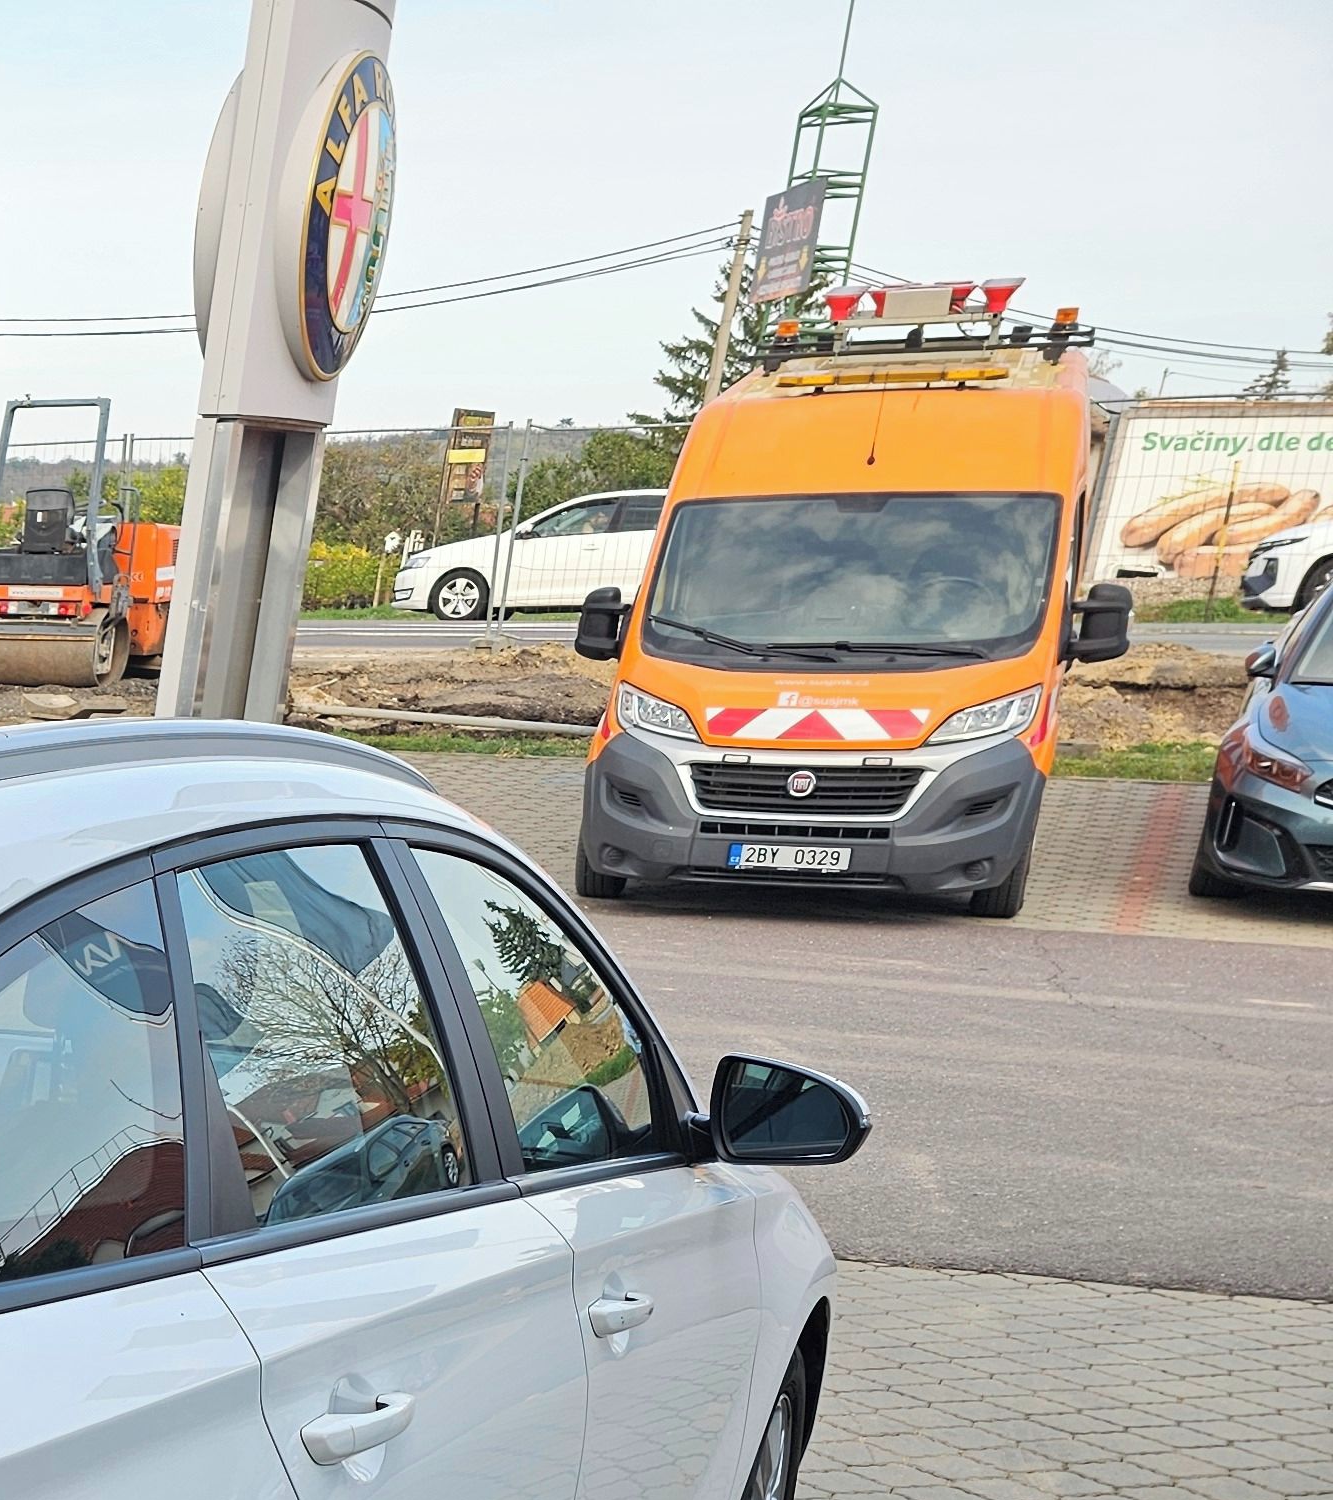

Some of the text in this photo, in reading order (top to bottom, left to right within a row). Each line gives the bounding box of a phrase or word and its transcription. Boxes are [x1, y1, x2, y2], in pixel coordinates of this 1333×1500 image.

[315, 72, 369, 218] ALFA
[1141, 430, 1248, 457] Svačiny
[1258, 432, 1300, 451] dle
[745, 847, 779, 864] 2BY
[794, 849, 841, 866] 0329
